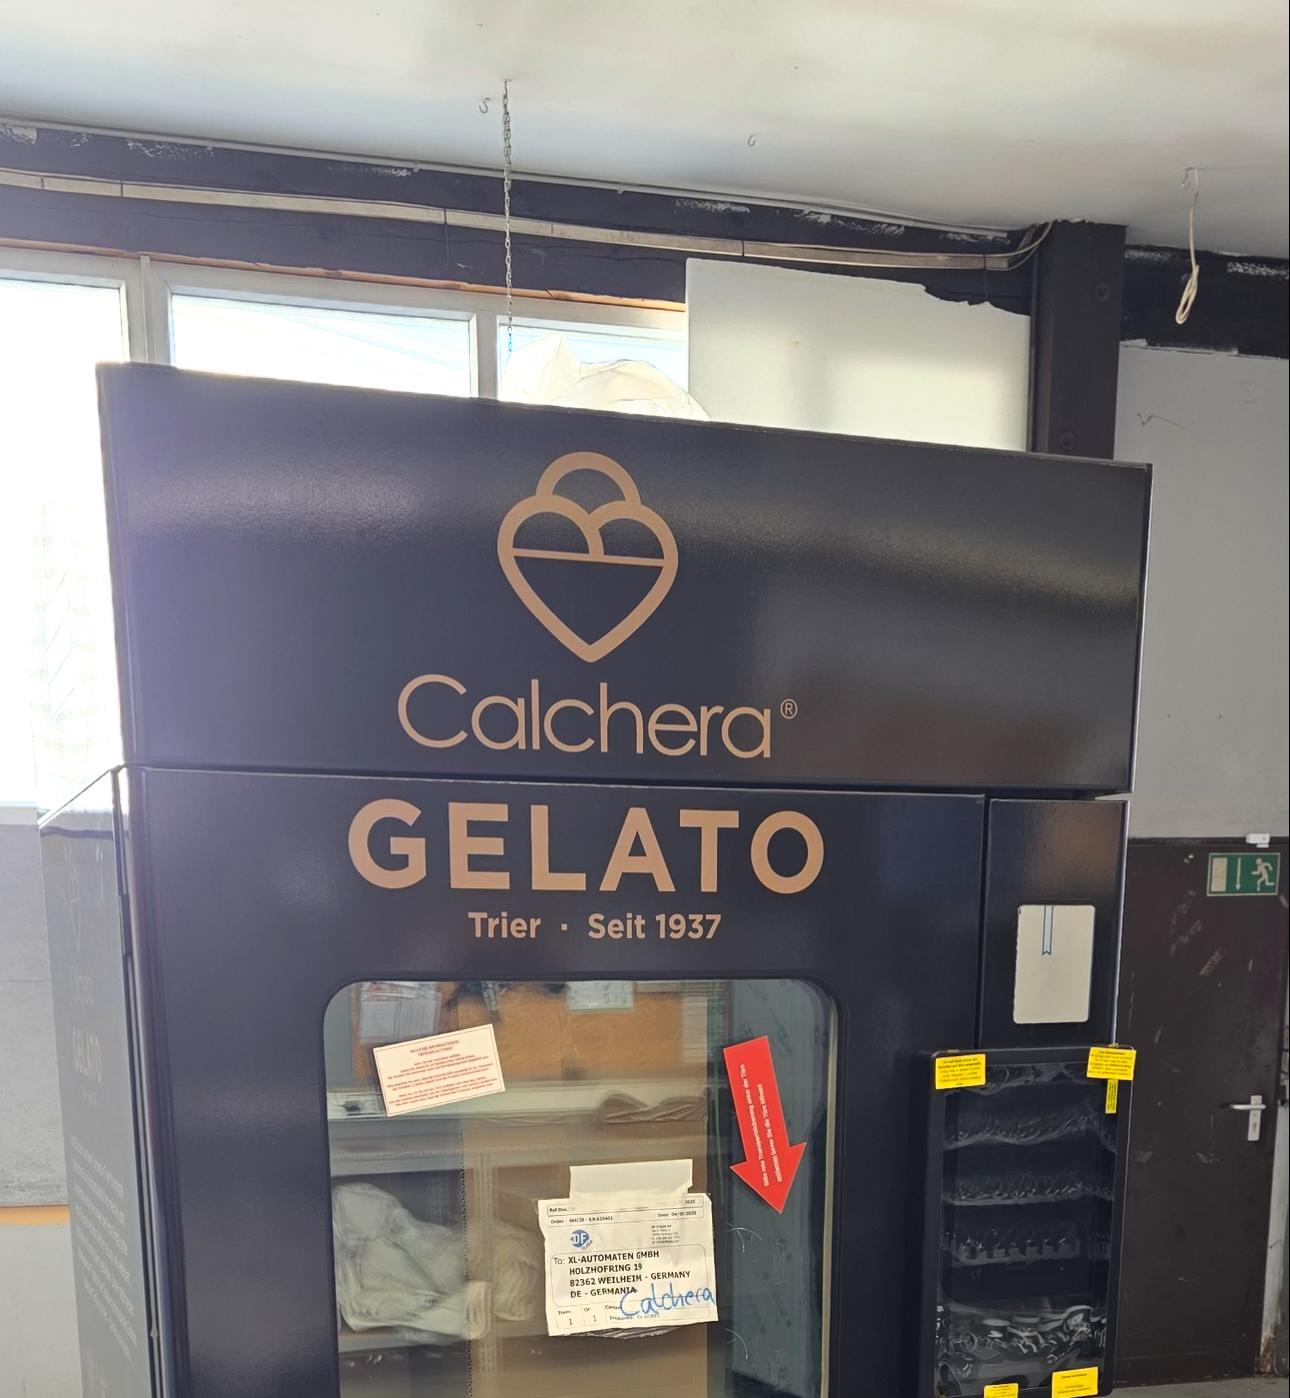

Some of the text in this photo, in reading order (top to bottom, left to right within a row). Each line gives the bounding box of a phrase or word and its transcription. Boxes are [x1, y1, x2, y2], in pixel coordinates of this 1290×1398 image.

[348, 798, 825, 894] GELATO
[468, 911, 541, 939] Trier
[587, 912, 646, 940] Seit
[655, 913, 722, 940] 1937
[552, 1250, 660, 1265] To: XL-AUTOMATEN GMBH
[569, 1263, 643, 1275] HOLZHOFRING 19
[569, 1277, 596, 1287] 82362
[598, 1274, 642, 1285] WEILHEIM
[650, 1270, 691, 1280] GERMANY
[570, 1290, 582, 1299] DE
[590, 1286, 637, 1296] GERMANIA
[619, 1281, 717, 1317] Calchera
